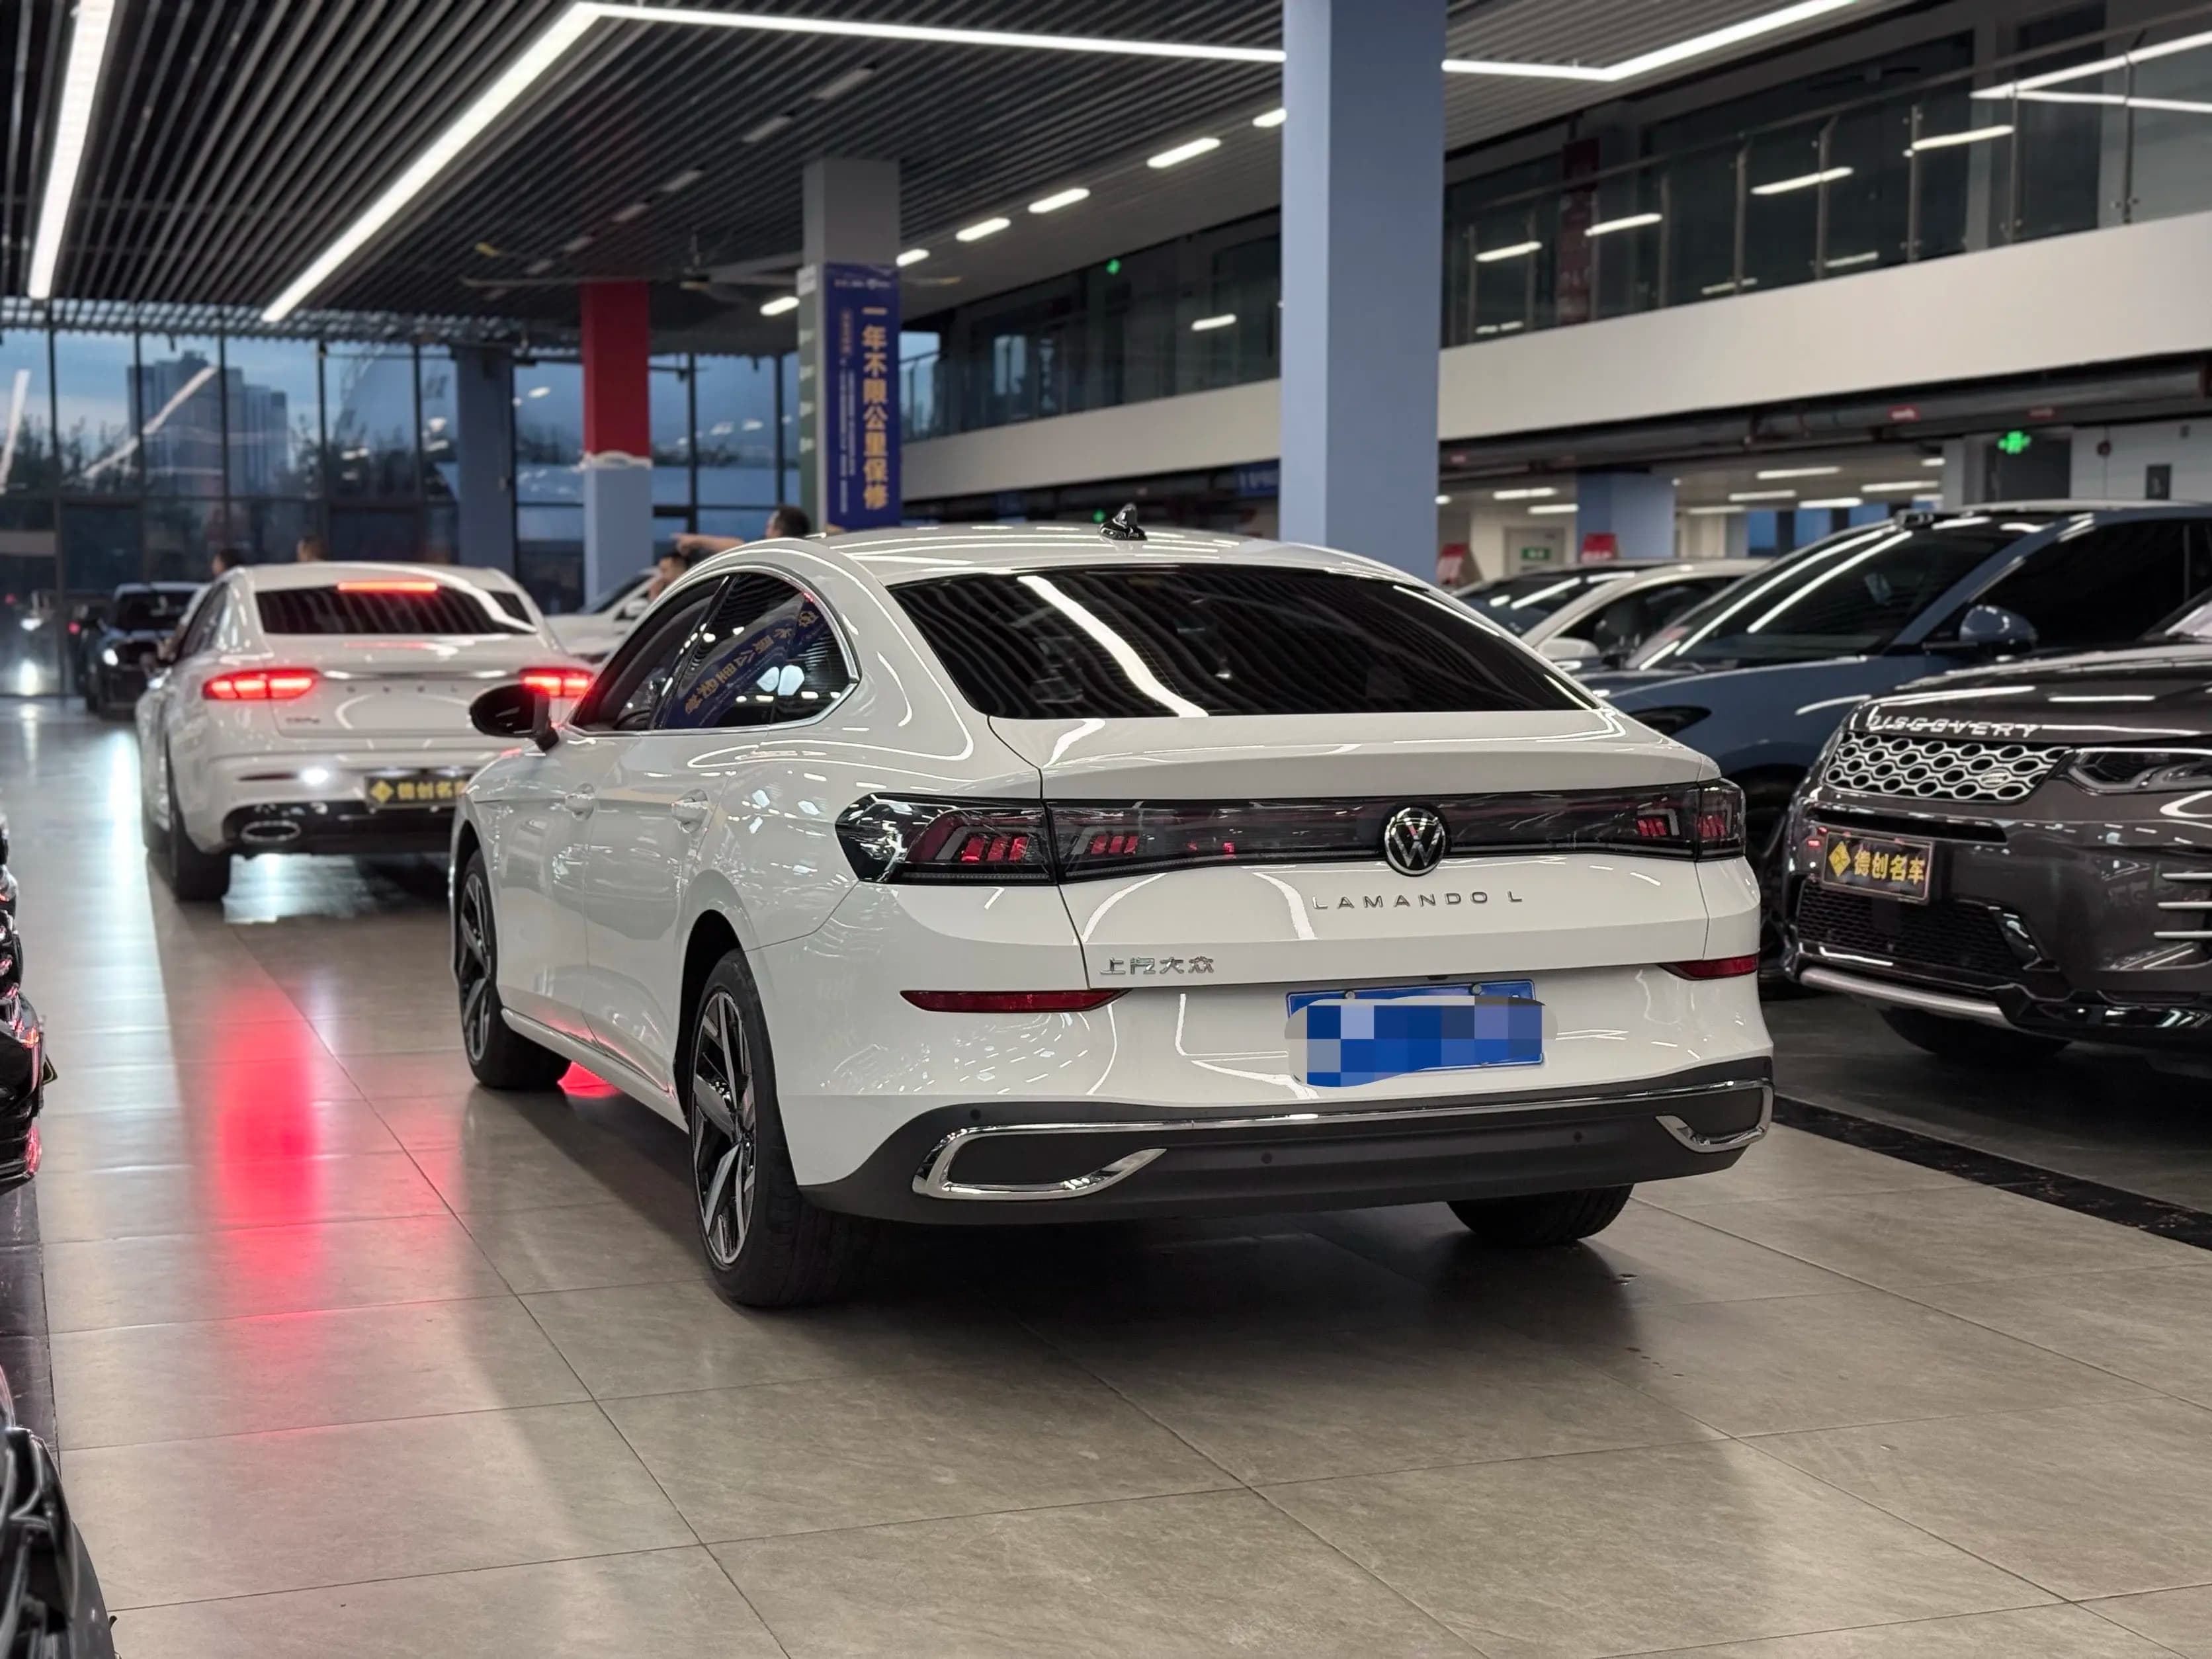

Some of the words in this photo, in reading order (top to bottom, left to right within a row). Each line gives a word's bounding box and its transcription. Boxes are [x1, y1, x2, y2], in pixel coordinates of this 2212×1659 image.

[862, 306, 888, 509] 一年不限公里保修
[1865, 714, 2040, 738] DISCOVERY
[1854, 845, 1926, 884] 德创名车
[1312, 891, 1488, 910] LAMANDO
[1508, 891, 1522, 903] L
[1100, 956, 1214, 975] 上汽大众
